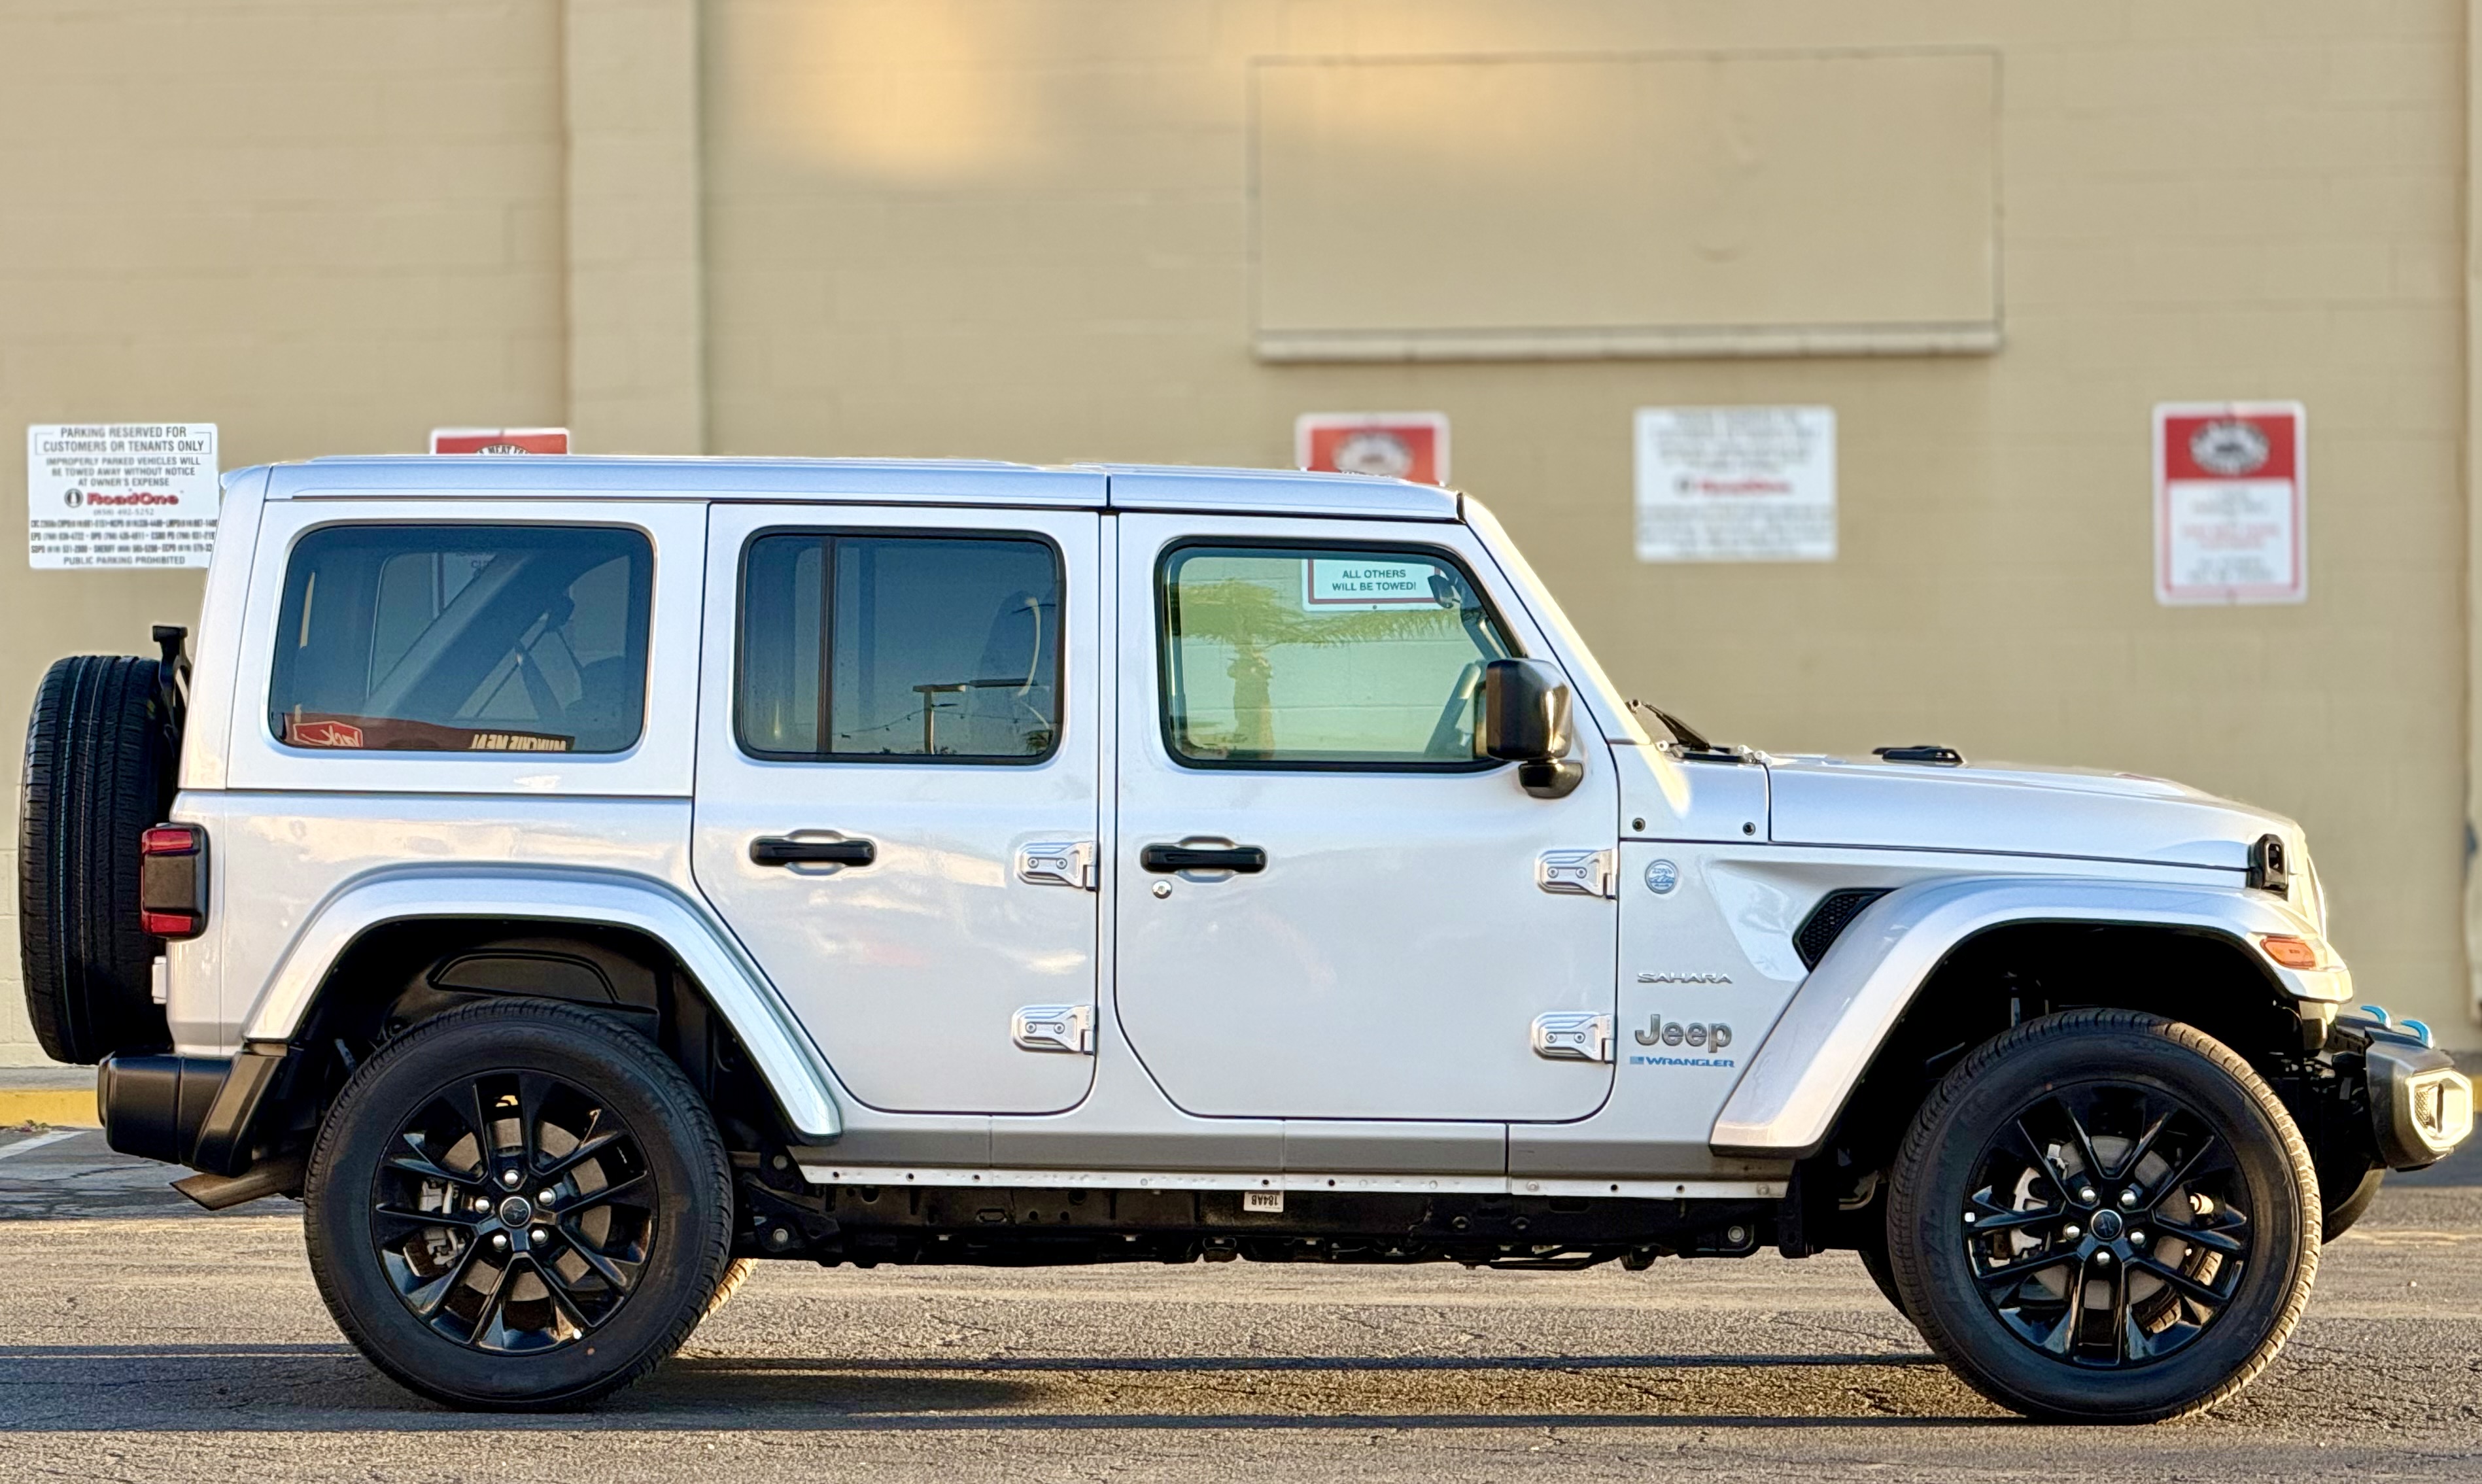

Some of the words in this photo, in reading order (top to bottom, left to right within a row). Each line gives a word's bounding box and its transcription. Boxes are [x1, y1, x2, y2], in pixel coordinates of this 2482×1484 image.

[61, 427, 105, 438] PARKING
[109, 426, 162, 438] RESERVED
[166, 426, 186, 438] FOR
[43, 441, 107, 452] CUSTOMERS
[111, 441, 125, 452] OR
[128, 440, 174, 451] TENANTS
[178, 440, 204, 451] ONLY
[46, 457, 99, 466] IMPROPERLY
[101, 457, 135, 466] PARKED
[137, 457, 177, 465] VEHICLES
[180, 457, 201, 465] WILL
[52, 468, 62, 476] BE
[65, 468, 95, 476] TOWED
[97, 468, 121, 476] AWAY
[124, 468, 162, 476] WITHOUT
[165, 467, 196, 476] NOTICE
[132, 477, 170, 486] EXPENSE
[87, 492, 179, 505] RoadOne
[135, 556, 185, 564] PROHIBITED
[1342, 570, 1362, 578] ALL
[1364, 569, 1407, 578] OTHERS
[1332, 582, 1357, 591] WILL
[1360, 582, 1374, 591] BE
[1376, 581, 1417, 591] TOWED!
[1637, 973, 1733, 984] SAHARA
[1635, 1014, 1732, 1054] Jeep
[1646, 1056, 1735, 1068] WRANGLER
